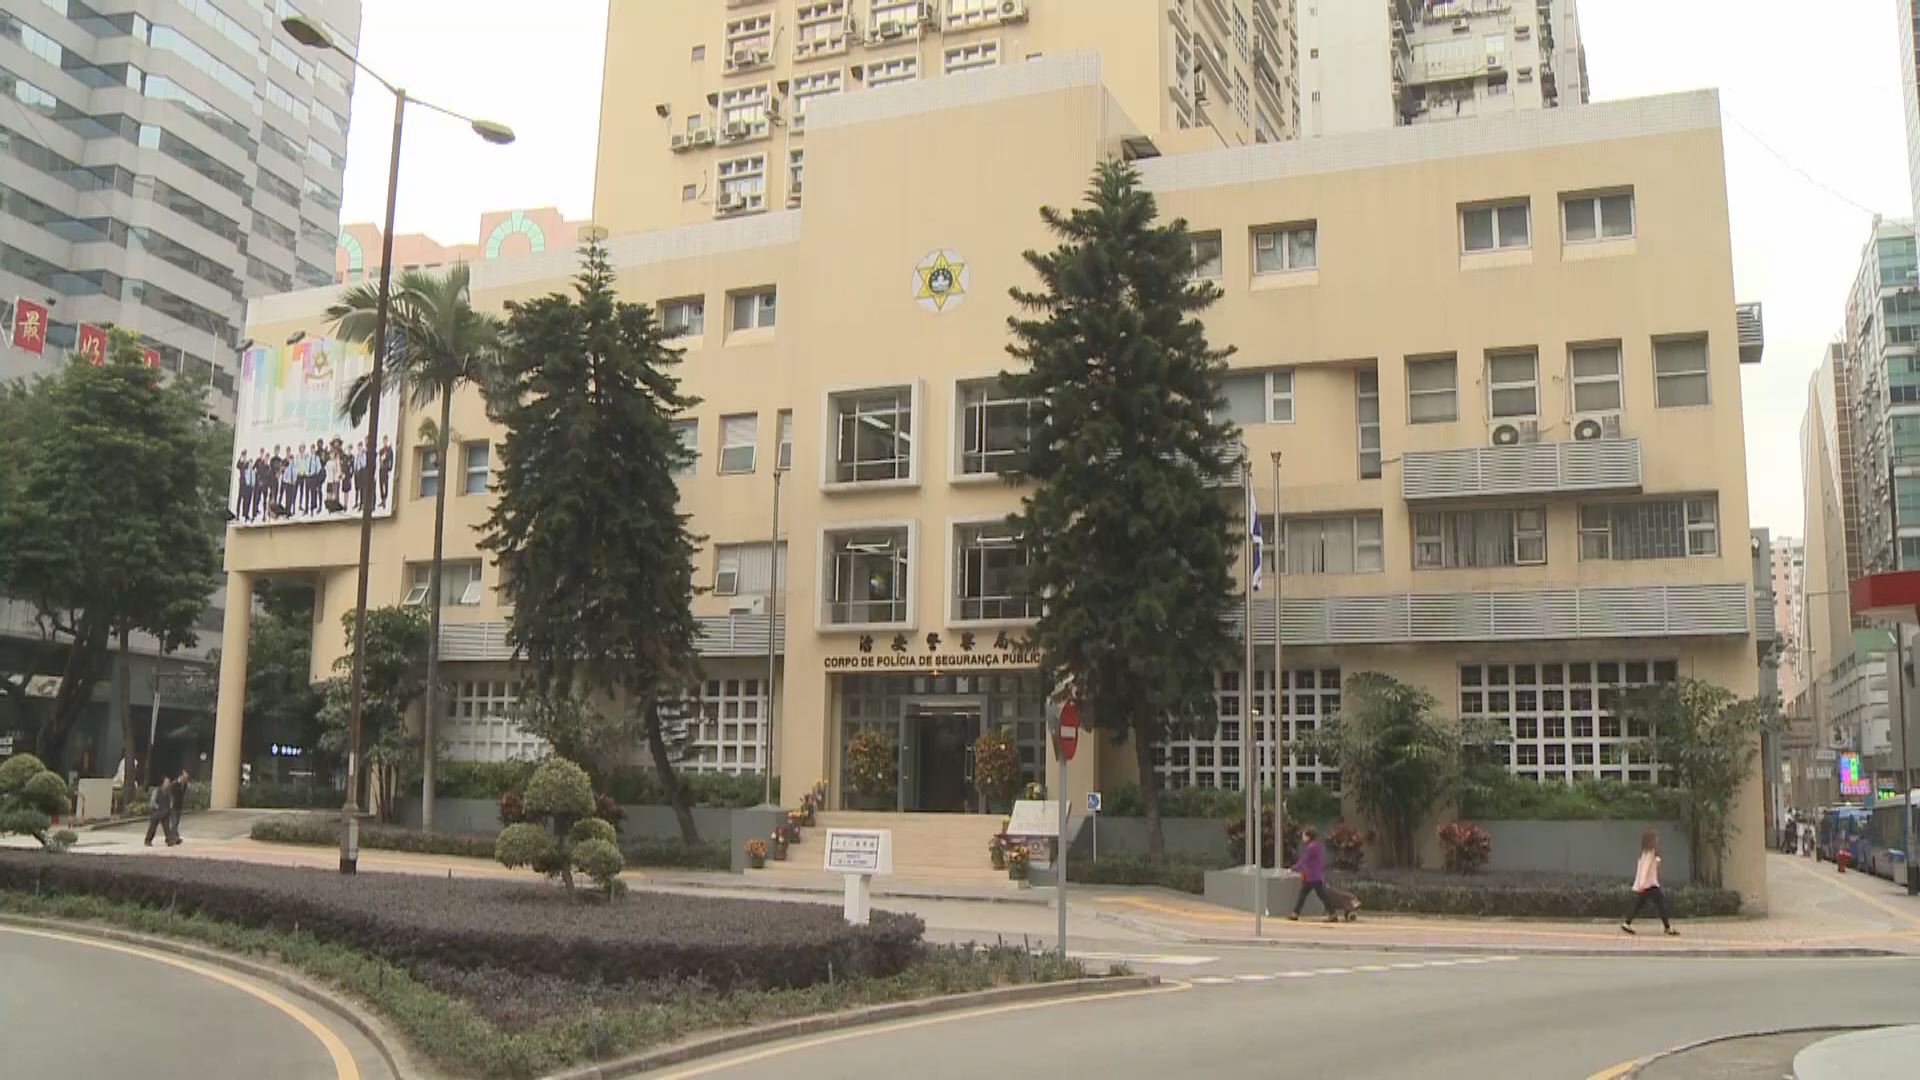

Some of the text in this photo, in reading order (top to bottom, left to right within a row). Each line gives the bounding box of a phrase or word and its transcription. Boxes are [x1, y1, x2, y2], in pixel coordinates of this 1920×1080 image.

[19, 310, 40, 342] 最
[824, 650, 1046, 668] CORPO DE POLÍCIA DE SEGURANÇA PÚBLIC
